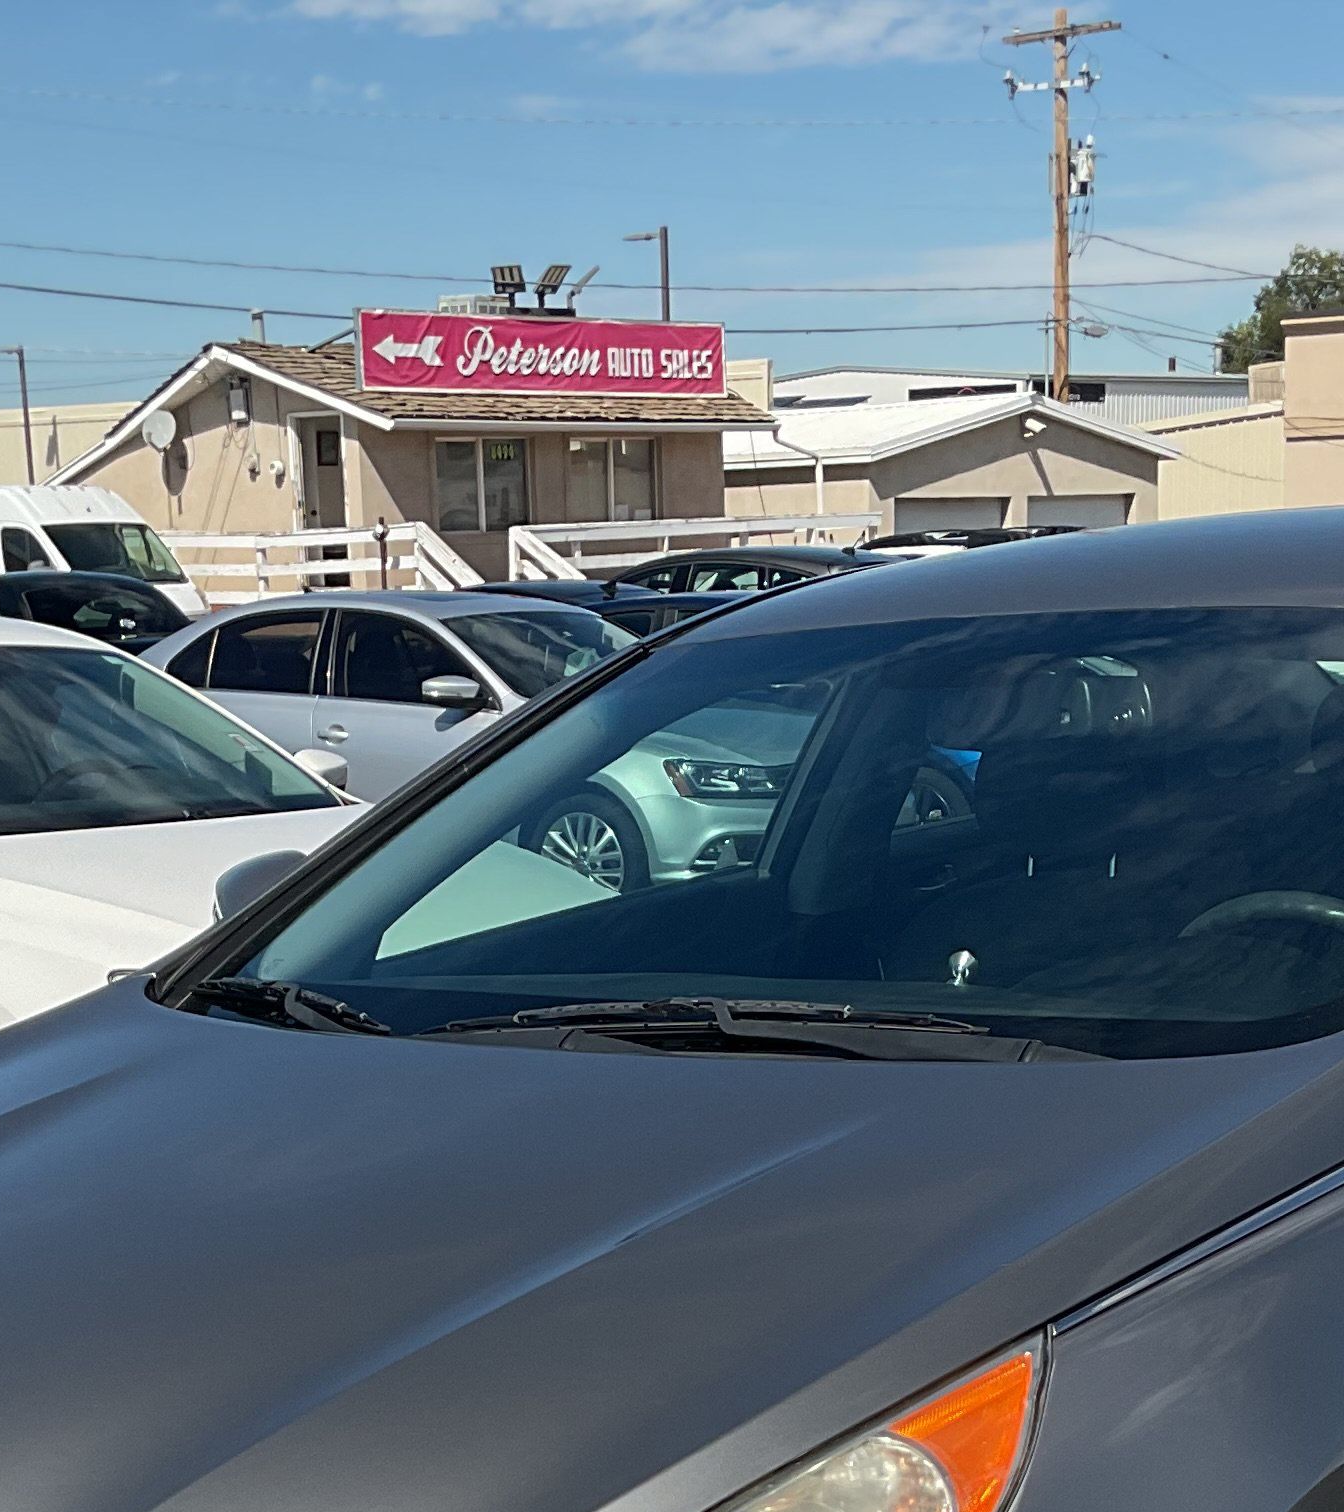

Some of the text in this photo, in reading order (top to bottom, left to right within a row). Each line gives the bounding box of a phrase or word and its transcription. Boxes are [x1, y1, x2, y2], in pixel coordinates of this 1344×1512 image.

[456, 325, 713, 379] Peterson AUTO SALES
